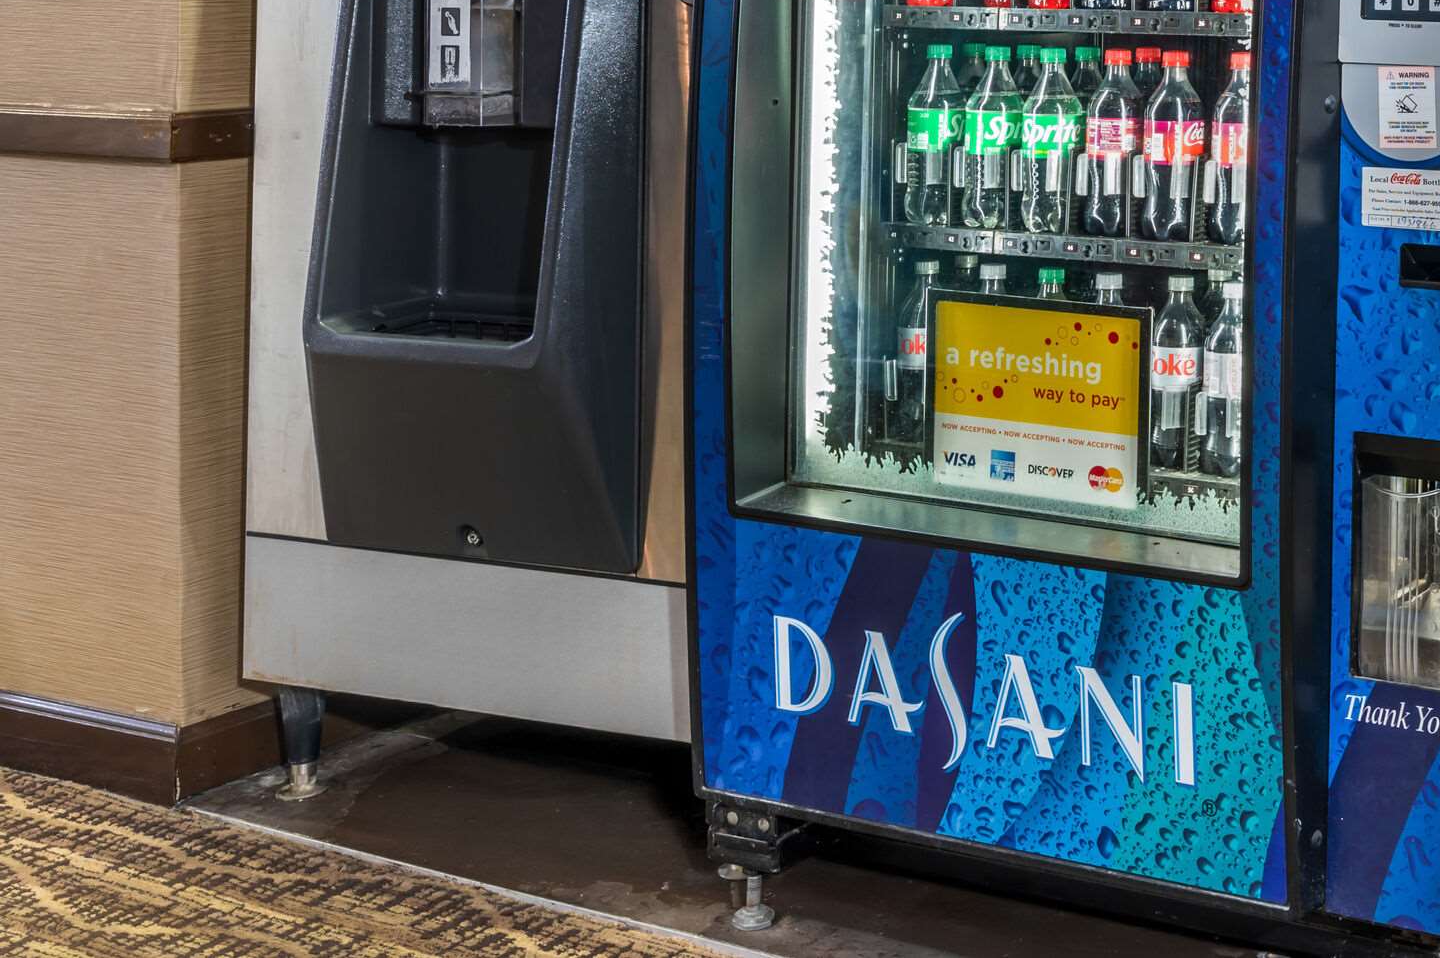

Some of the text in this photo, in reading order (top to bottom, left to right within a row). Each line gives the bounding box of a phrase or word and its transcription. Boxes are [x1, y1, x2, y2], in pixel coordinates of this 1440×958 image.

[1022, 115, 1081, 144] Sprite
[1369, 175, 1389, 183] Local
[945, 344, 1103, 385] a refreshing
[1033, 386, 1064, 405] way
[1069, 387, 1086, 404] to
[941, 421, 1126, 452] NOW ACCEPTING NOW ACCEPTING NOW ACCEPTING
[943, 450, 976, 468] VISA
[1027, 463, 1075, 480] DISCOVER
[771, 609, 1197, 787] DASANI
[1344, 693, 1411, 732] Thank
